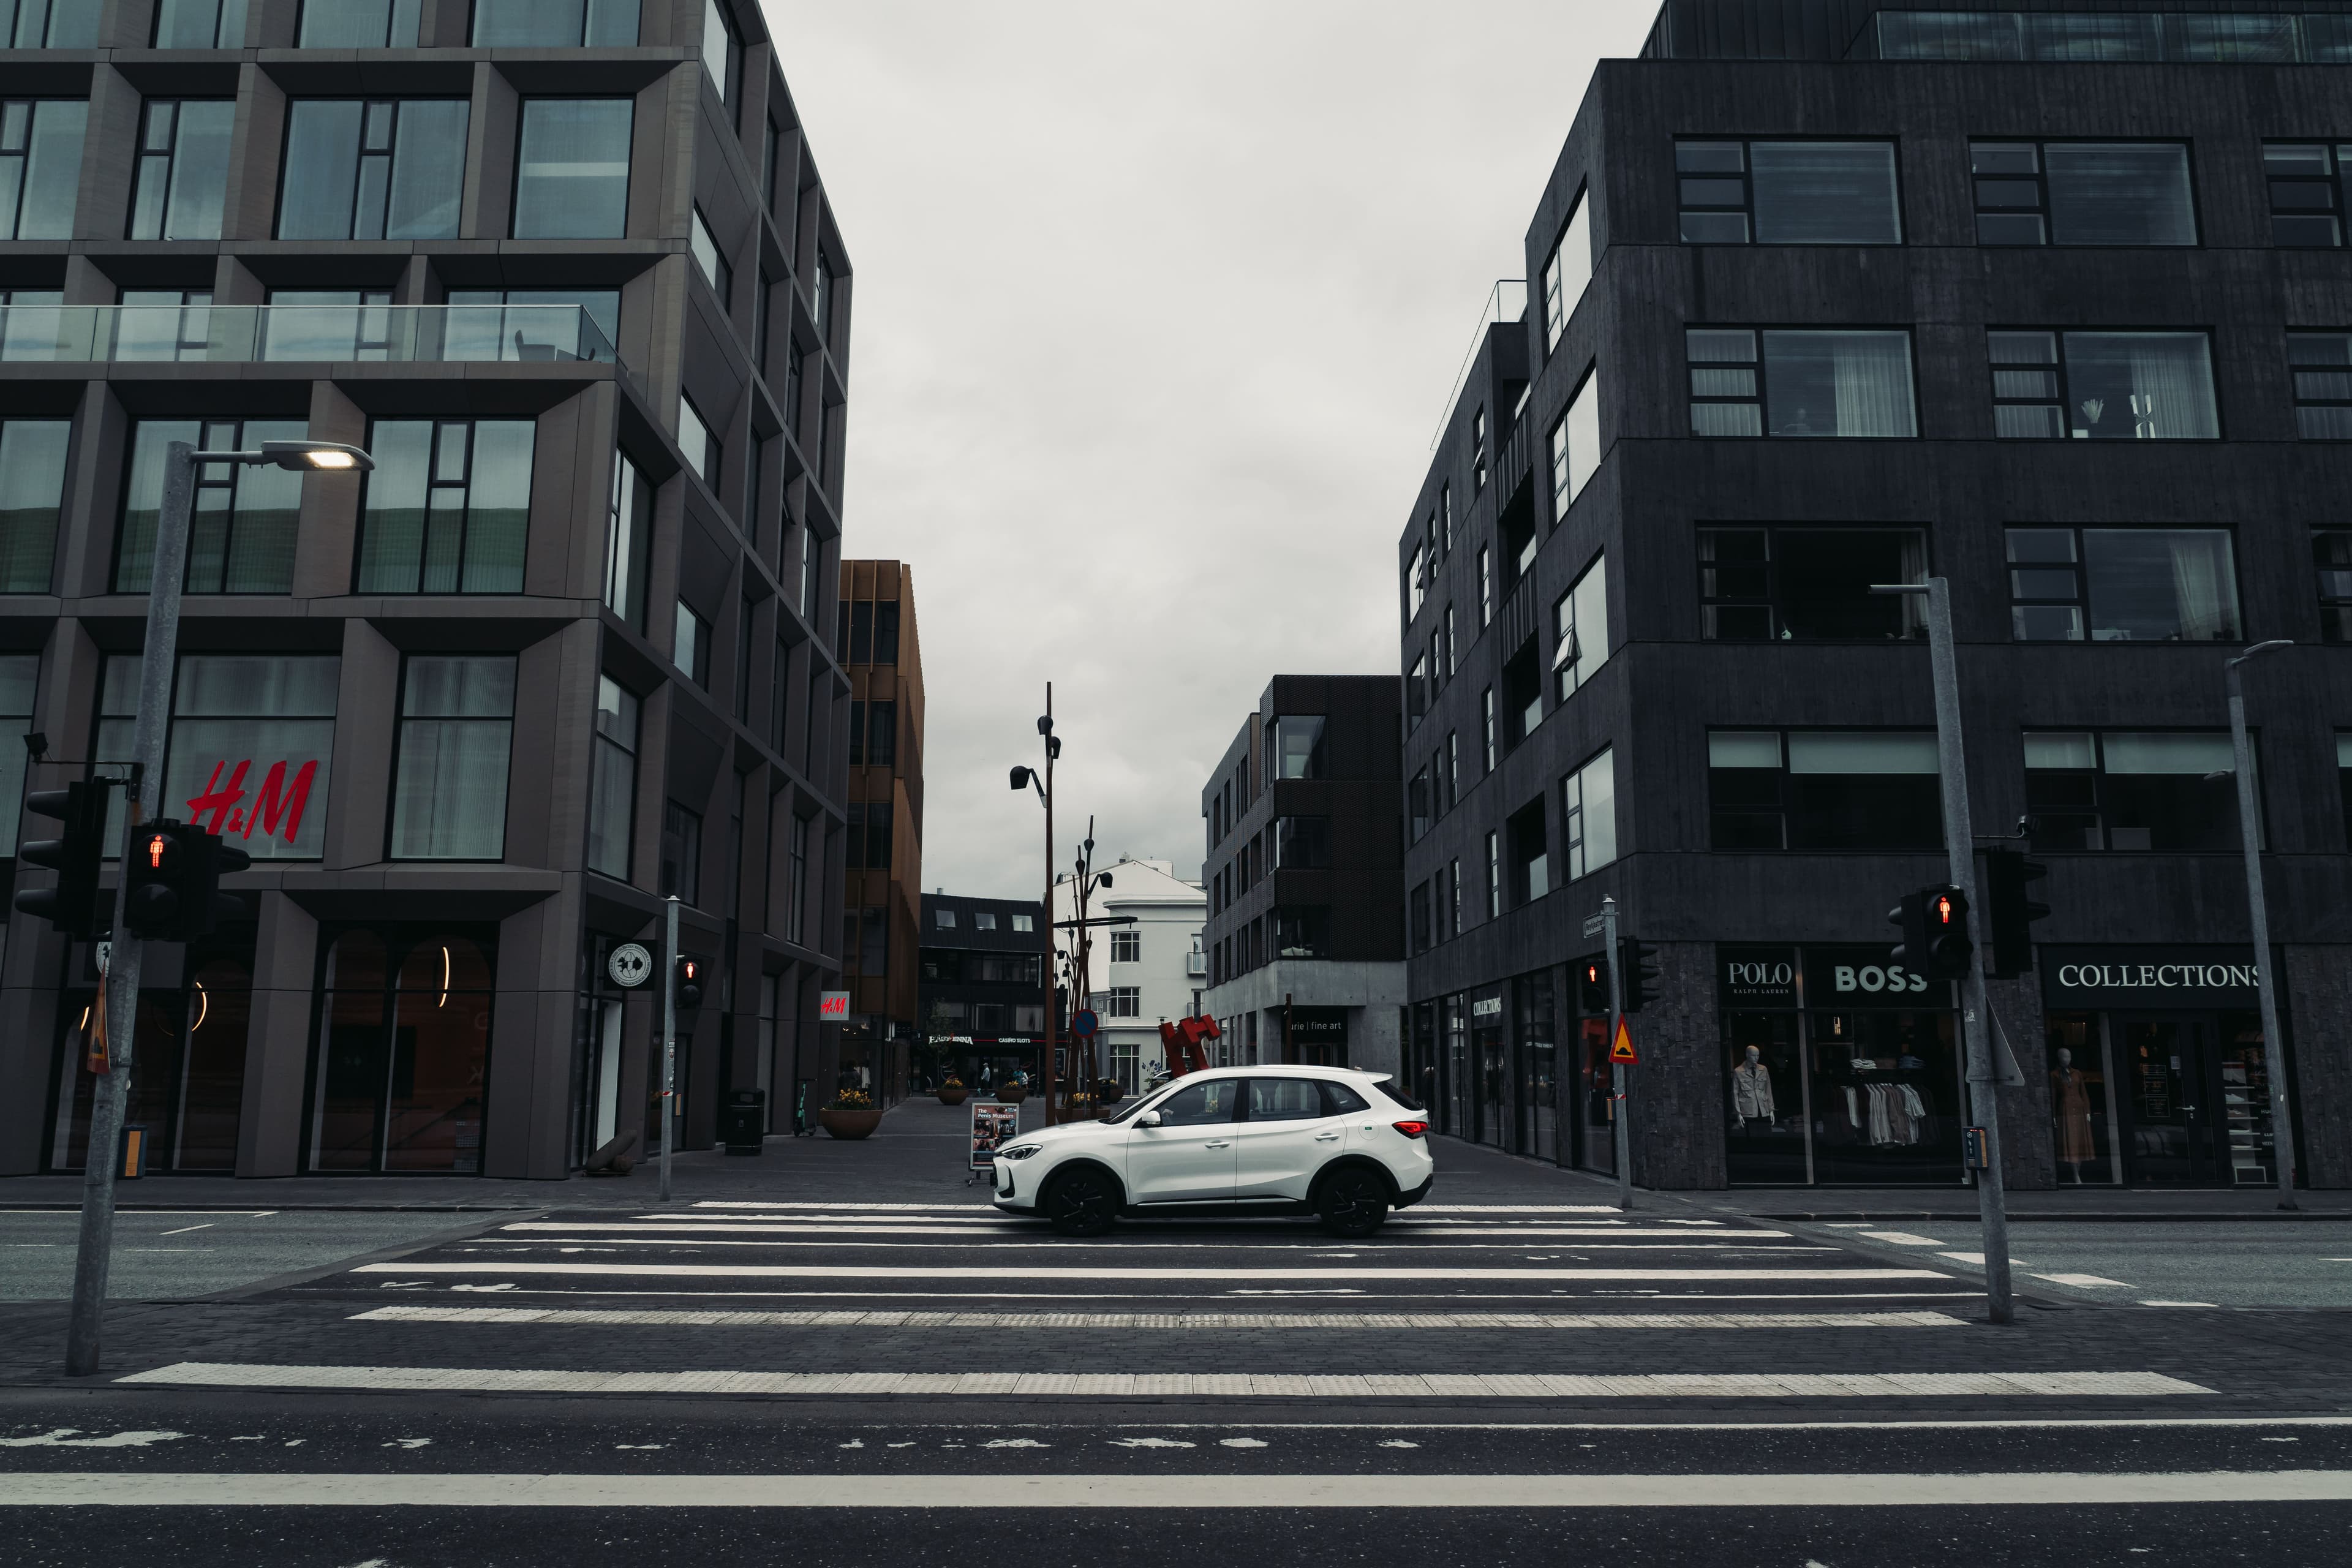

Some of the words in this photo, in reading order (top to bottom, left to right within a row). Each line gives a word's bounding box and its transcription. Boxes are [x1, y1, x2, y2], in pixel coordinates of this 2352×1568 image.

[186, 759, 318, 843] H&M
[1727, 962, 1792, 984] POLO
[1834, 965, 1928, 992] BOSS
[820, 997, 846, 1014] H&M
[1473, 997, 1501, 1017] COLLECTIONS
[1311, 1021, 1327, 1030] fine
